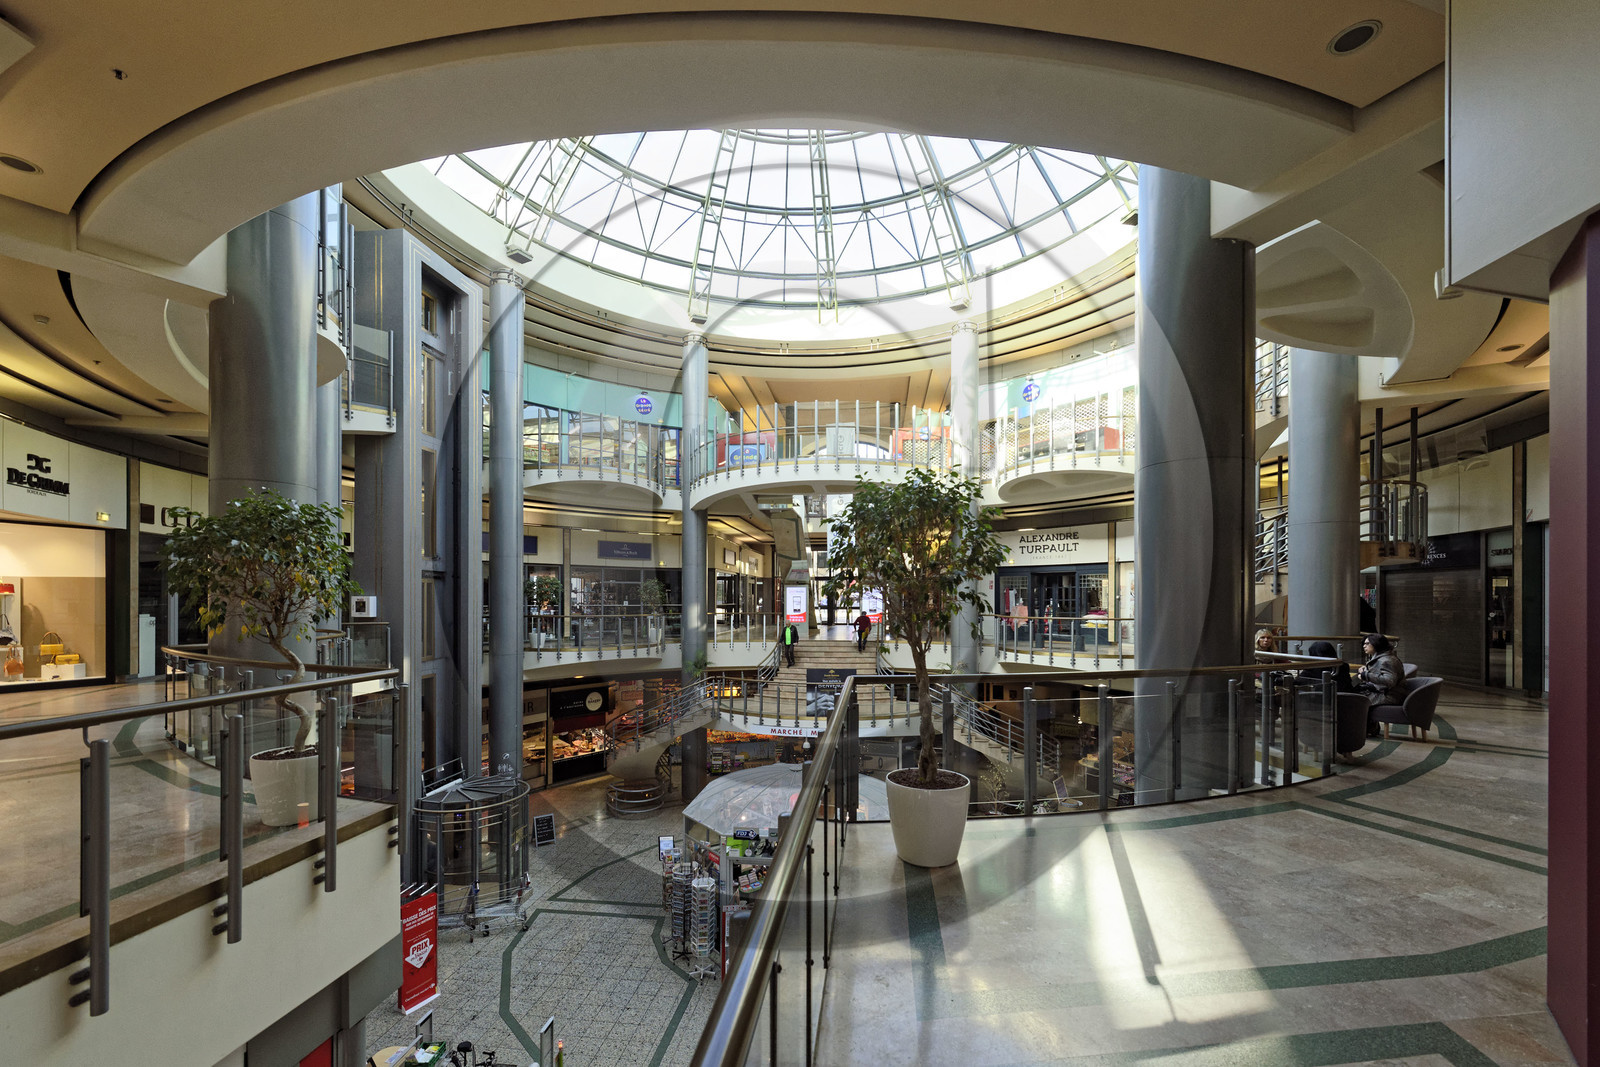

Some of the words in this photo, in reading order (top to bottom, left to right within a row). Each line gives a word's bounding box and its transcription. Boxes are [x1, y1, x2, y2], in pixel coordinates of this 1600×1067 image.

[1019, 532, 1079, 543] ALEXANDRE
[1019, 543, 1079, 554] TURPAULT
[770, 728, 803, 736] MARCHÉ
[427, 905, 437, 914] PRIX
[411, 940, 429, 955] PRIX
